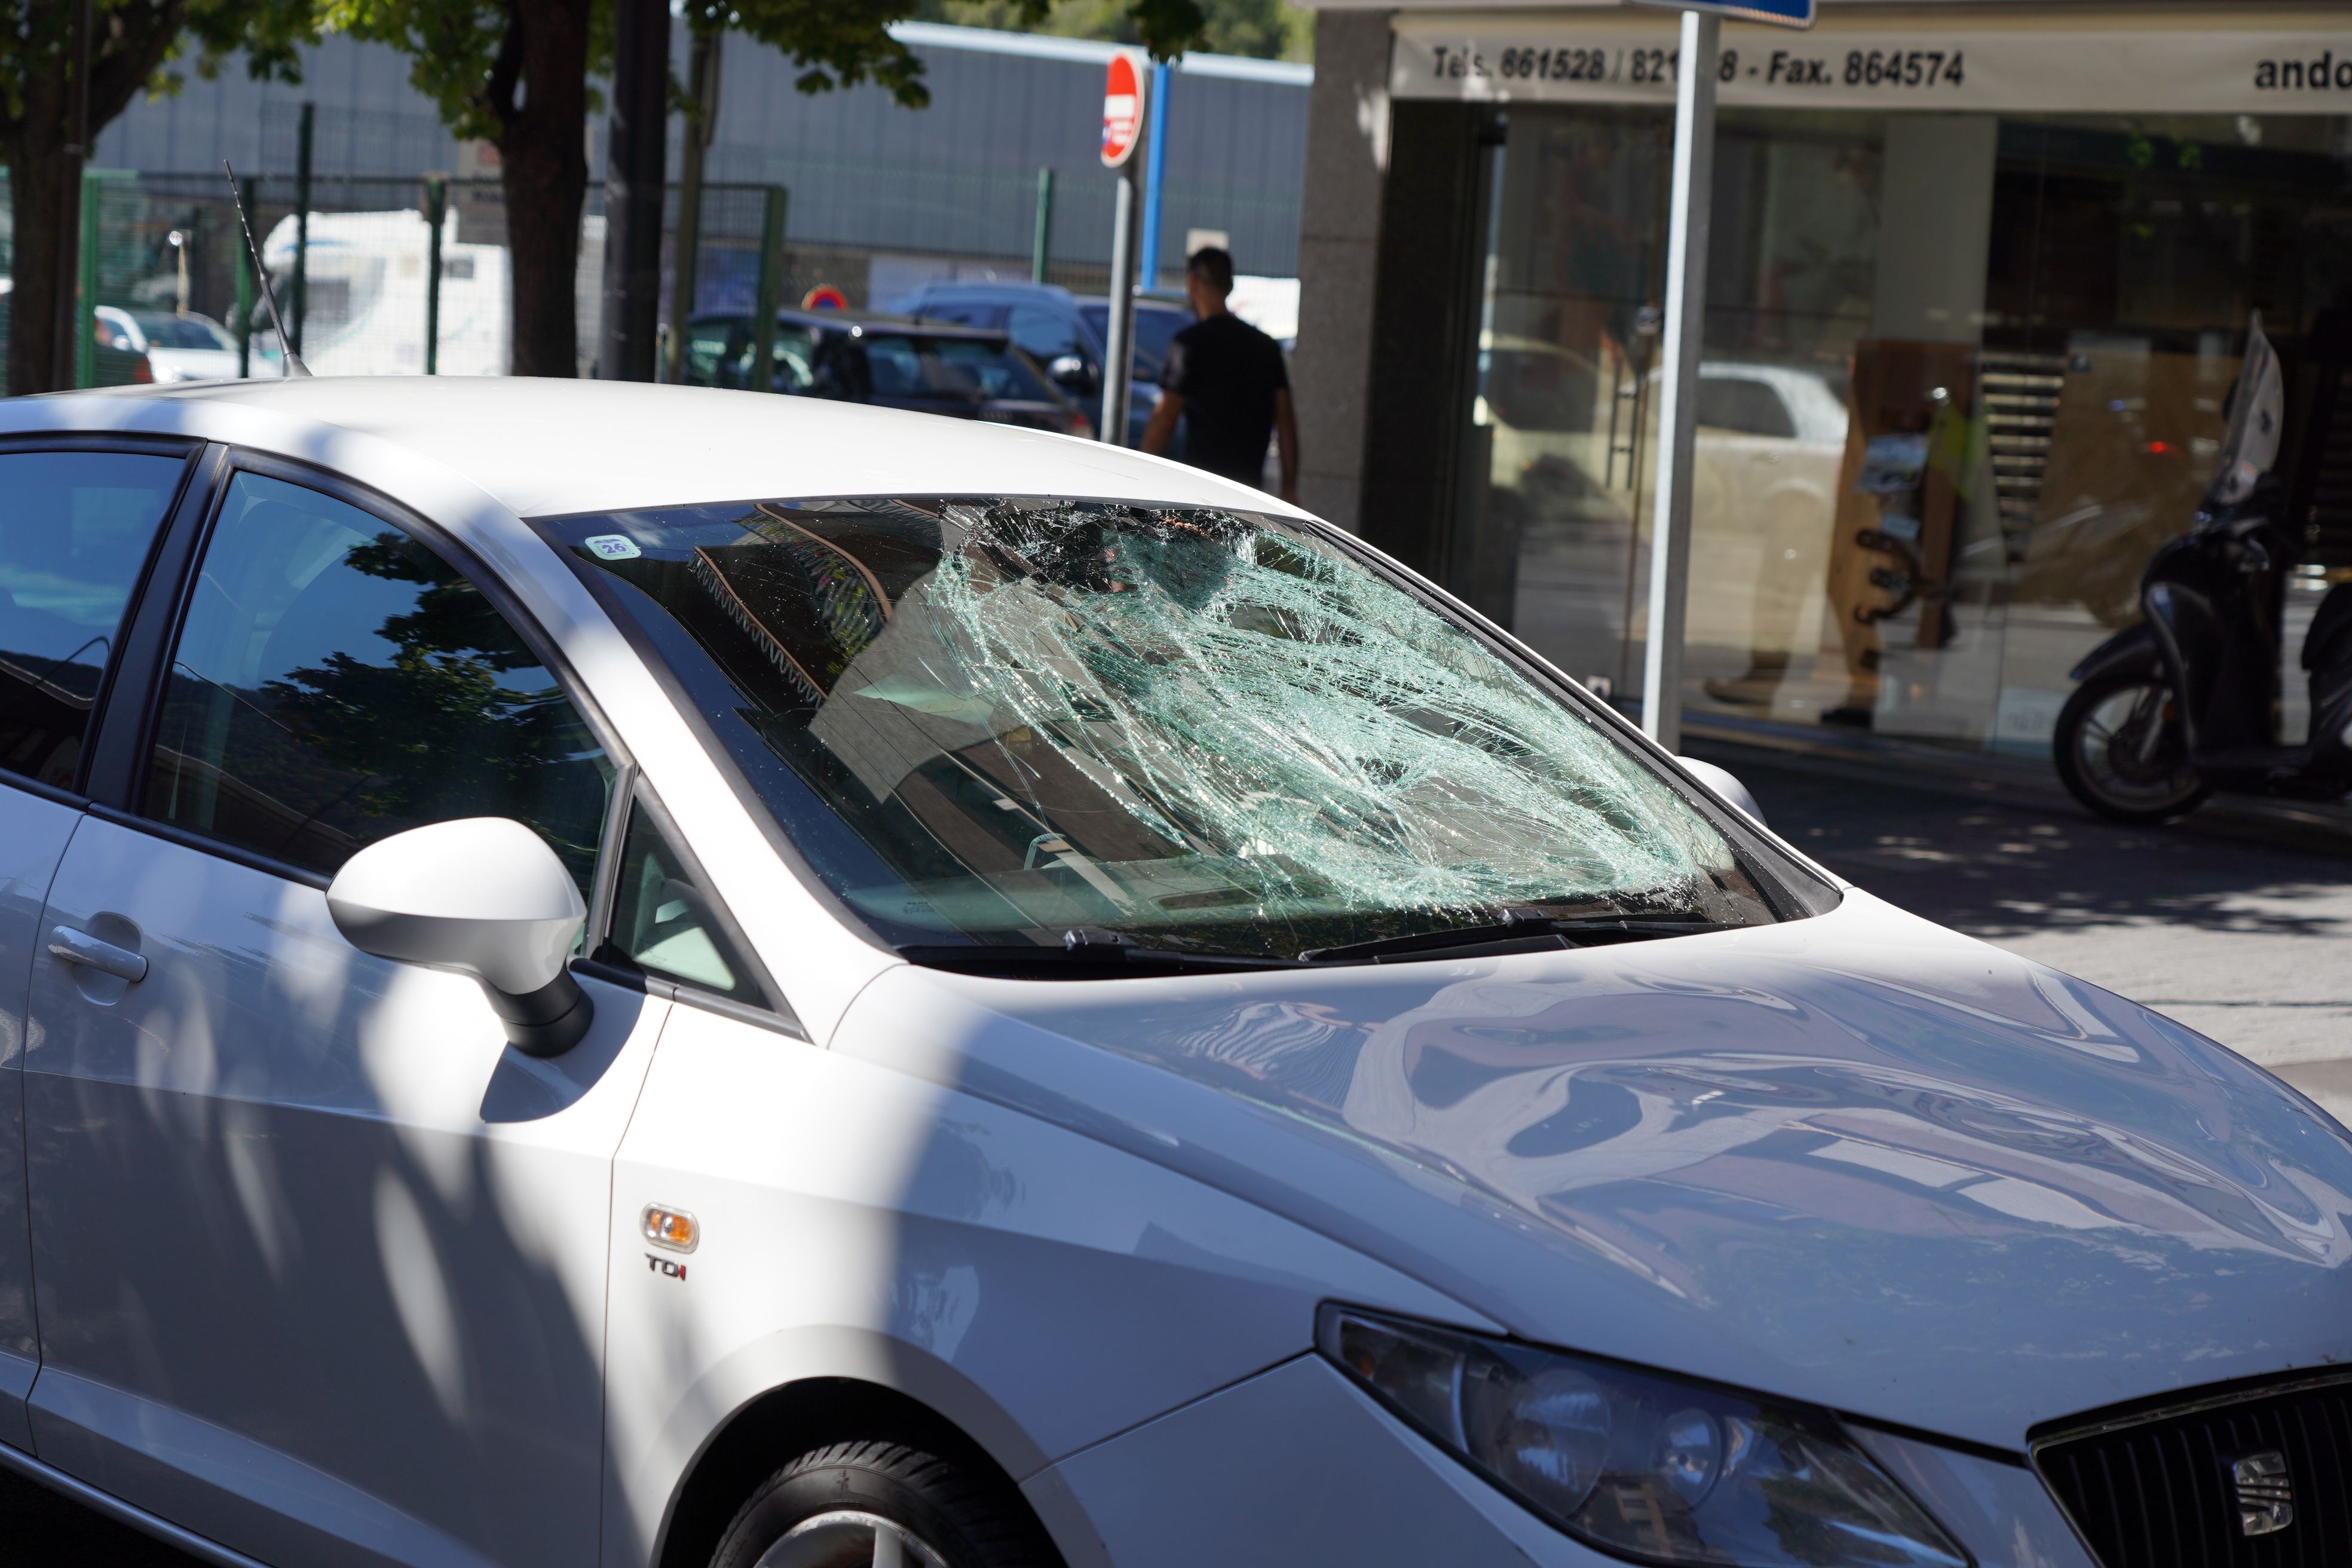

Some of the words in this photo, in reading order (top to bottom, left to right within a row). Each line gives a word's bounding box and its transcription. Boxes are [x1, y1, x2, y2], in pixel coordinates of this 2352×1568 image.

[1501, 47, 1604, 81] 861528
[1632, 49, 1738, 82] 8218
[1767, 50, 1832, 84] Fax.
[1844, 50, 1964, 85] 864574
[2255, 51, 2352, 90] ando
[602, 544, 627, 554] 26
